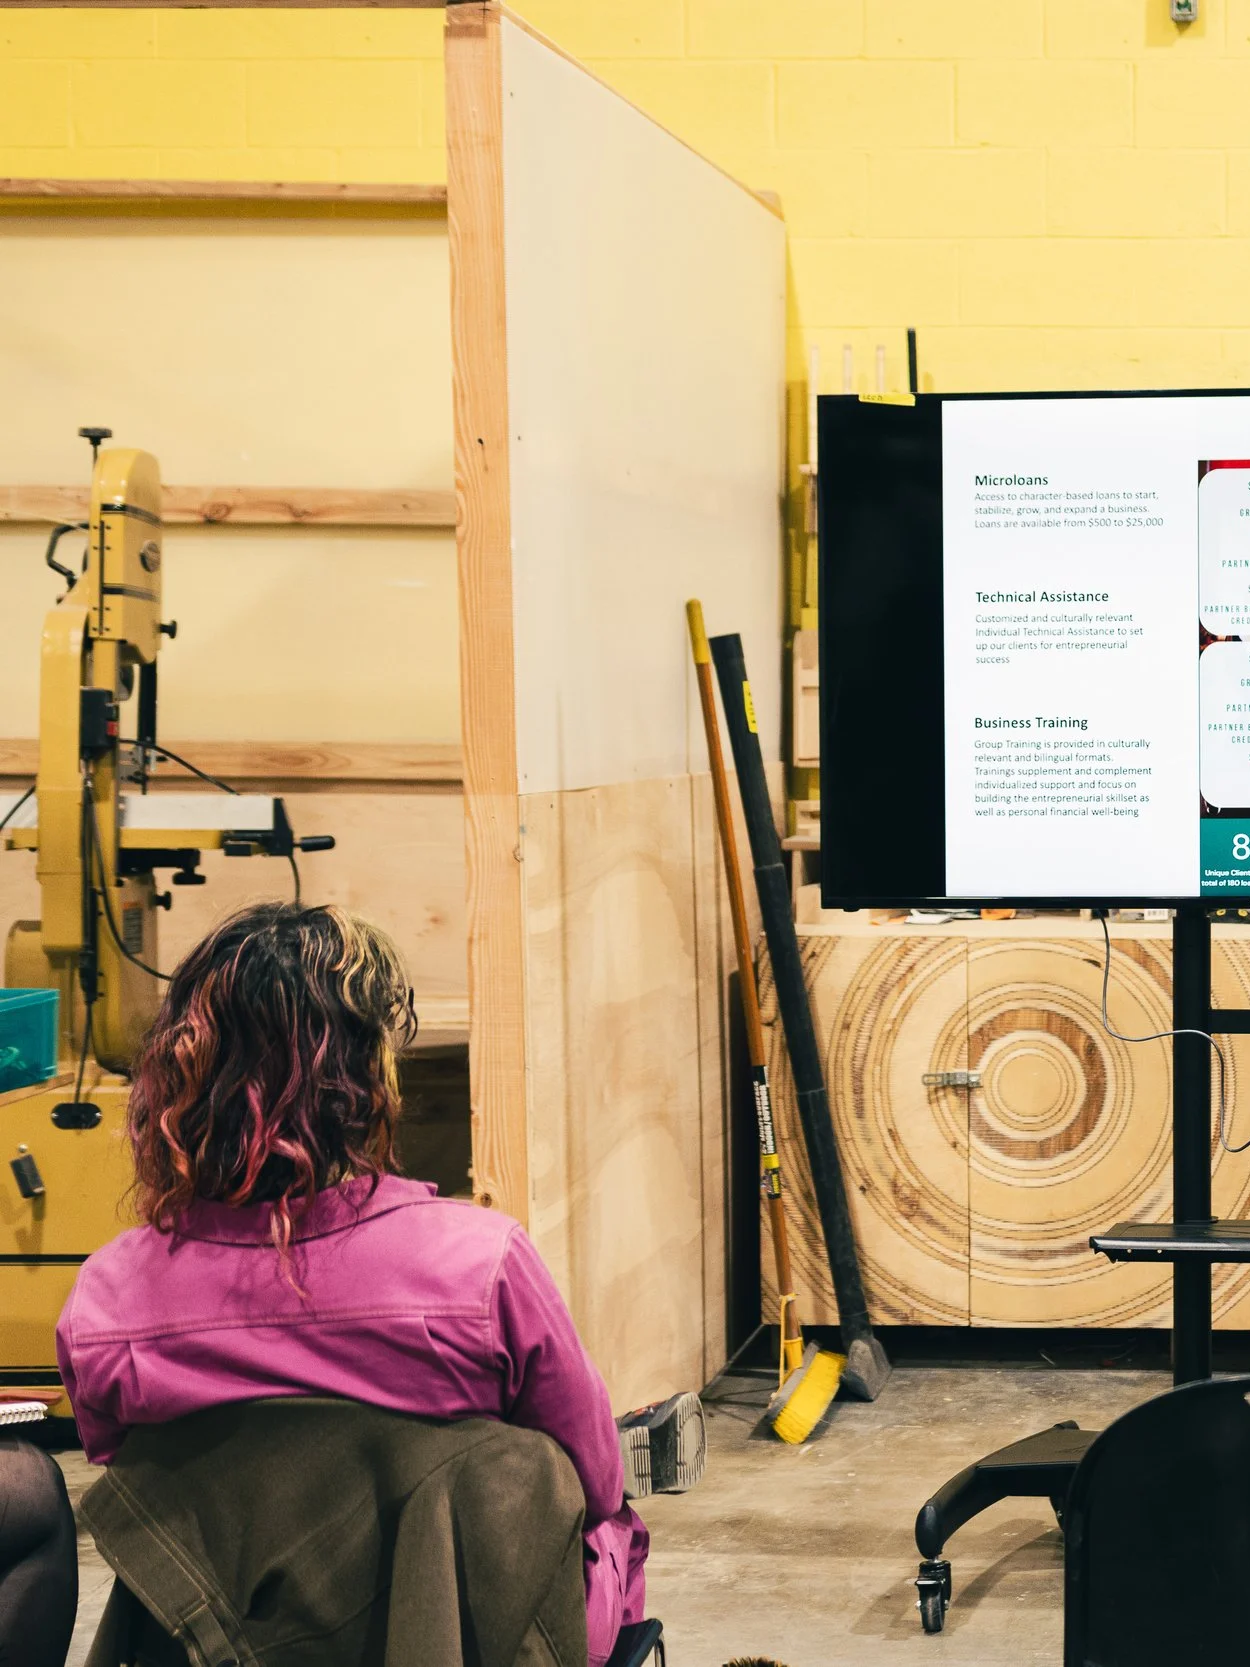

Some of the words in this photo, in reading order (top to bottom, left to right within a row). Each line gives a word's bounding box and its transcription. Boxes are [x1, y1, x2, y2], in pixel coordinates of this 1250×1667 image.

[975, 474, 1048, 486] Microloans
[974, 493, 1005, 501] Access
[1019, 491, 1093, 501] character-based
[1096, 491, 1120, 500] loans
[1044, 505, 1062, 514] and
[1064, 505, 1098, 515] expand
[1108, 505, 1149, 513] business.
[1021, 519, 1061, 527] available
[1064, 519, 1086, 527] from
[1088, 518, 1112, 528] $500
[1126, 518, 1164, 527] $25,000
[976, 591, 1036, 603] Technical
[1040, 591, 1109, 602] Assistance
[975, 614, 1028, 623] Customized
[1031, 614, 1048, 622] and
[1050, 613, 1093, 623] culturally
[1095, 613, 1133, 622] relevant
[976, 628, 1020, 637] Individual
[1023, 627, 1064, 636] Technical
[1067, 627, 1115, 636] Assistance
[1130, 628, 1143, 636] set
[976, 643, 988, 651] up
[1008, 642, 1038, 650] clients
[1040, 641, 1053, 650] for
[1055, 640, 1128, 651] entrepreneurial
[975, 717, 1031, 728] Business
[1035, 716, 1088, 731] Training
[974, 740, 1003, 750] Group
[1006, 740, 1042, 751] Training
[1053, 740, 1094, 750] provided
[1097, 740, 1105, 748] in
[1107, 739, 1151, 749] culturally
[975, 754, 1012, 762] relevant
[1014, 753, 1031, 762] and
[1034, 753, 1073, 764] bilingual
[1075, 752, 1113, 762] formats.
[975, 767, 1015, 778] Trainings
[1018, 767, 1072, 776] supplement
[1074, 767, 1092, 775] and
[1094, 766, 1152, 776] complement
[975, 780, 1037, 789] individualized
[1040, 781, 1076, 790] support
[1078, 780, 1095, 789] and
[1098, 780, 1122, 789] focus
[975, 794, 1012, 804] building
[1014, 794, 1029, 803] the
[1031, 794, 1103, 804] entrepreneurial
[1106, 794, 1137, 802] skillset
[975, 808, 993, 816] well
[1008, 807, 1047, 817] personal
[1050, 807, 1088, 816] financial
[1091, 807, 1139, 818] well-being
[1205, 869, 1230, 877] Unique
